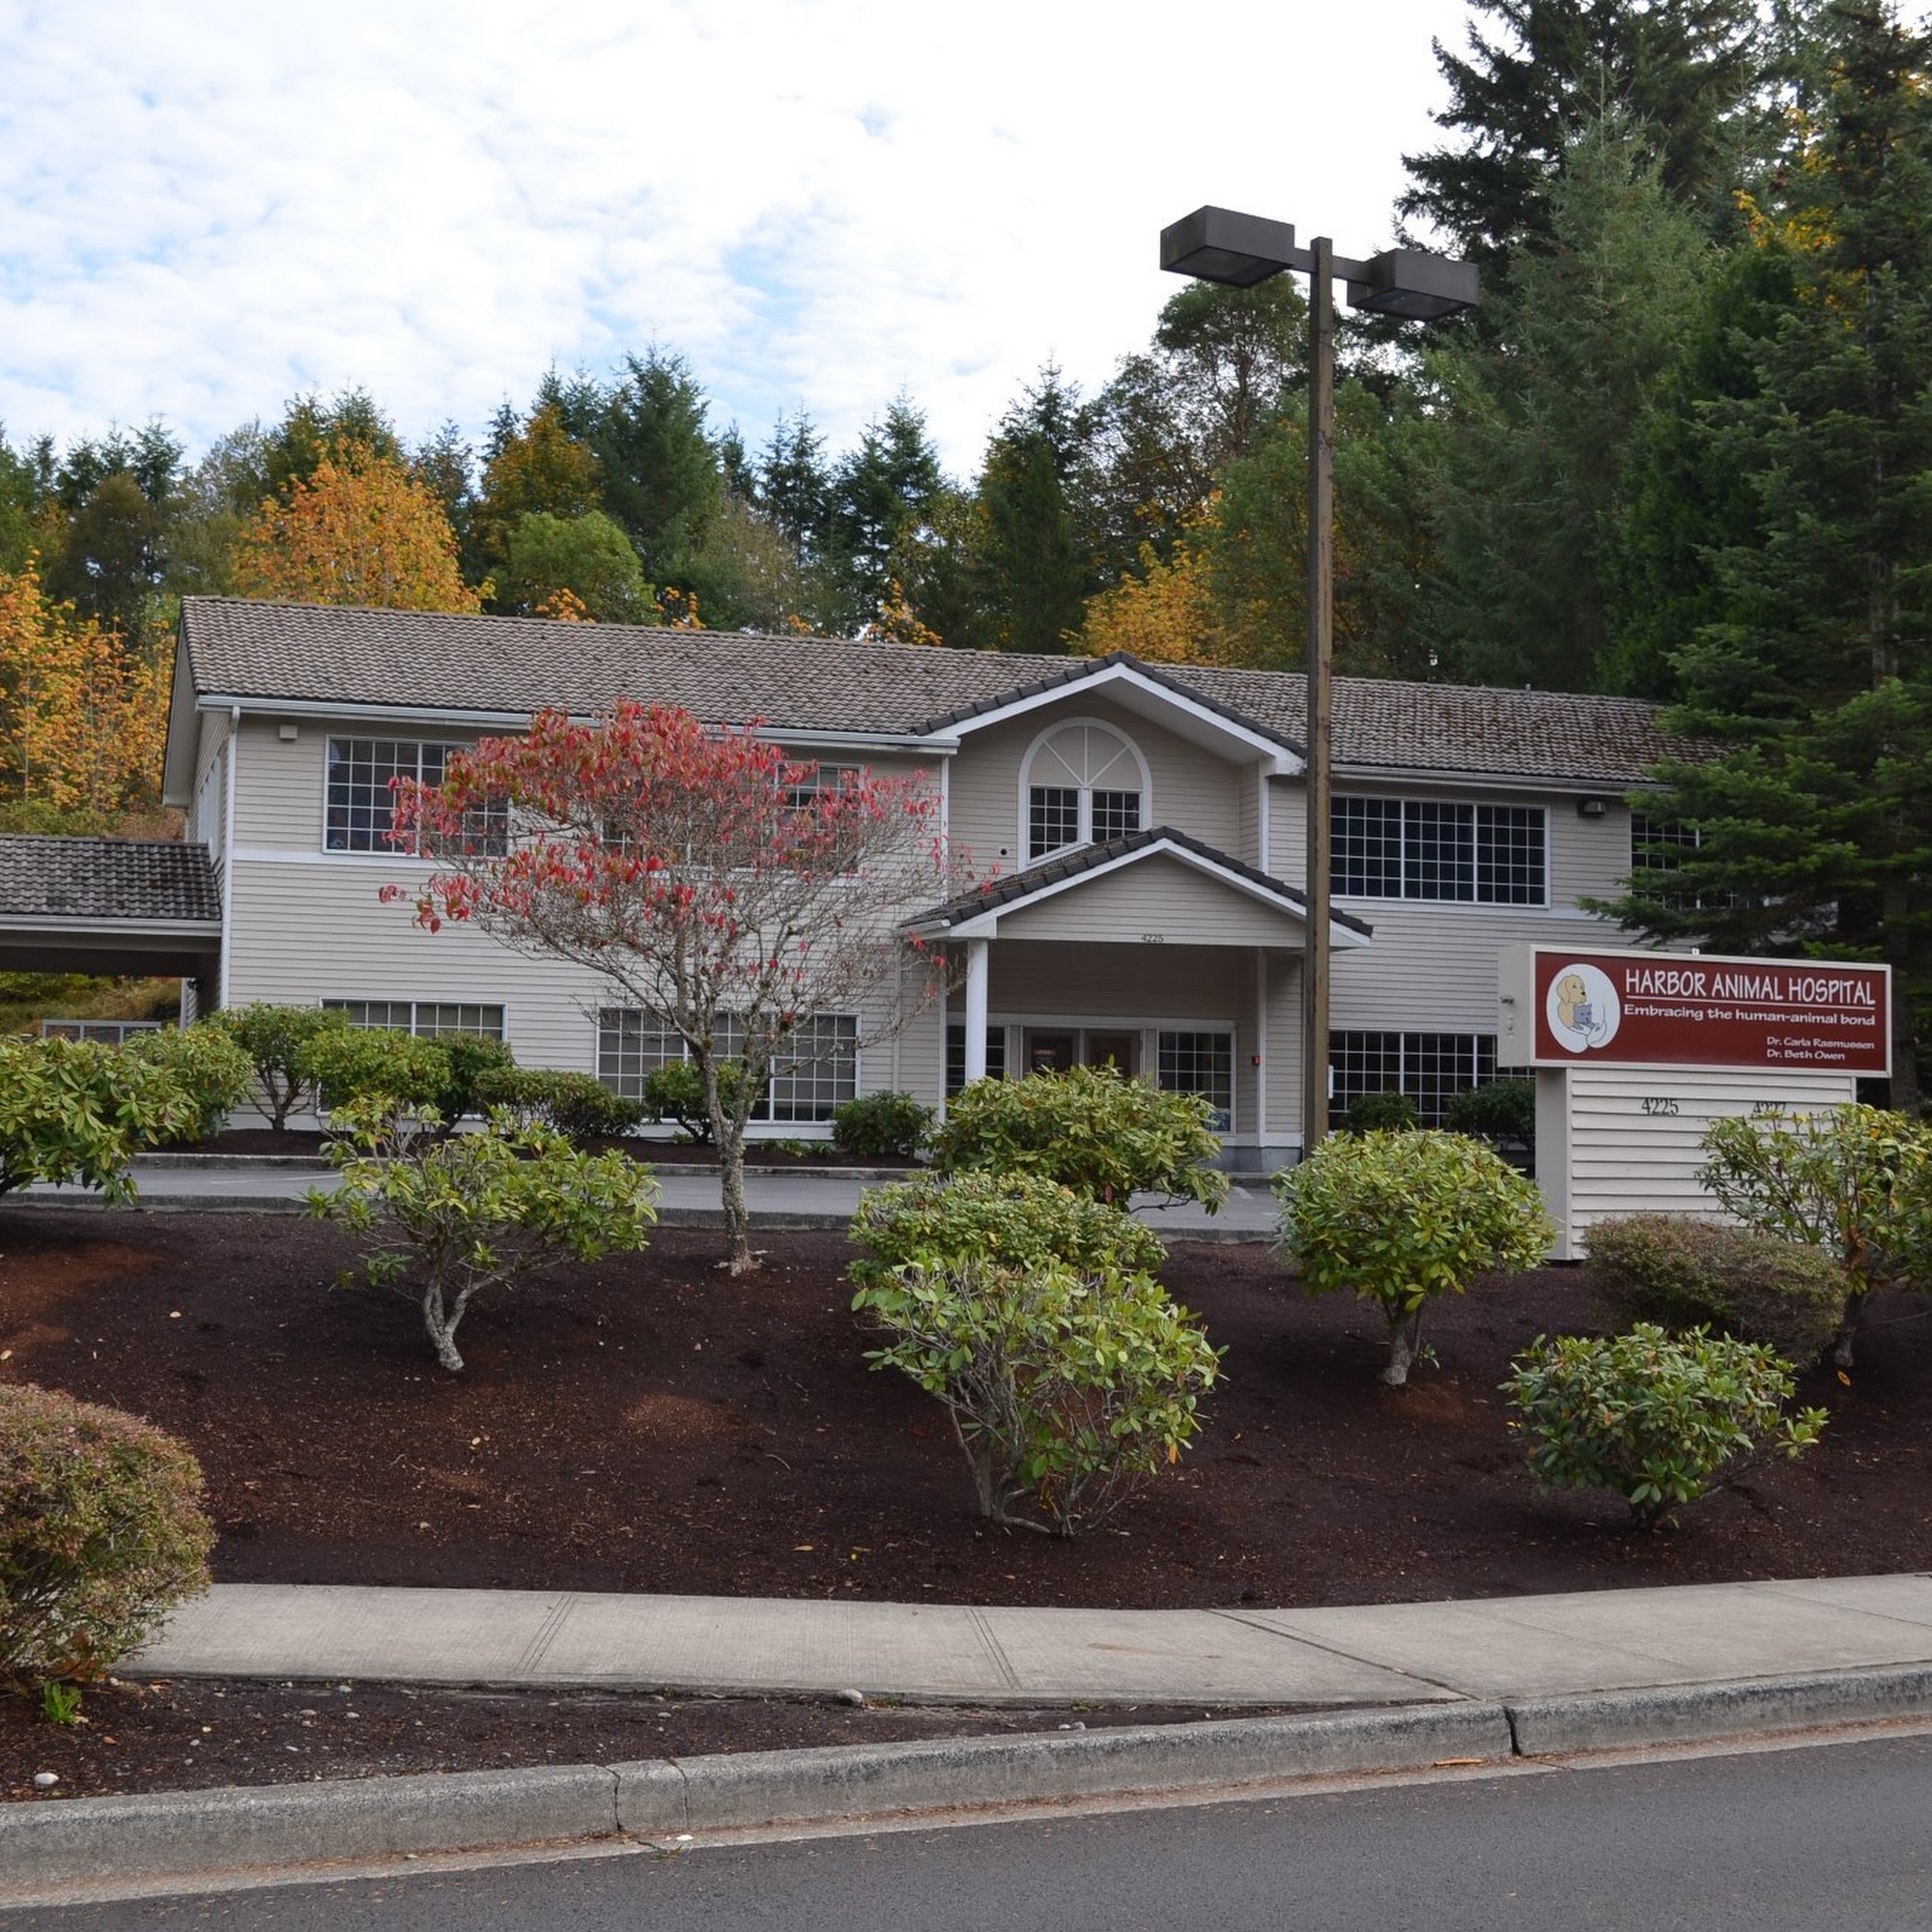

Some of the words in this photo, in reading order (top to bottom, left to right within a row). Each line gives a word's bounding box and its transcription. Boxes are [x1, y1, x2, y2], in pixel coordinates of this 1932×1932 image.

[1140, 933, 1165, 944] 4225
[1625, 968, 1707, 997] HARBOR
[1711, 972, 1784, 1001] ANIMAL
[1788, 977, 1876, 1006] HOSPITAL
[1624, 1004, 1704, 1021] Embracing
[1707, 1009, 1733, 1020] the
[1735, 1009, 1837, 1024] human-animal
[1840, 1013, 1876, 1026] bond
[1766, 1037, 1782, 1046] Dr.
[1783, 1037, 1811, 1047] Carla
[1812, 1038, 1875, 1050] Rasmussen
[1766, 1049, 1782, 1059] Dr.
[1784, 1050, 1813, 1060] Beth
[1814, 1051, 1846, 1061] Owen
[1641, 1097, 1680, 1116] 4225
